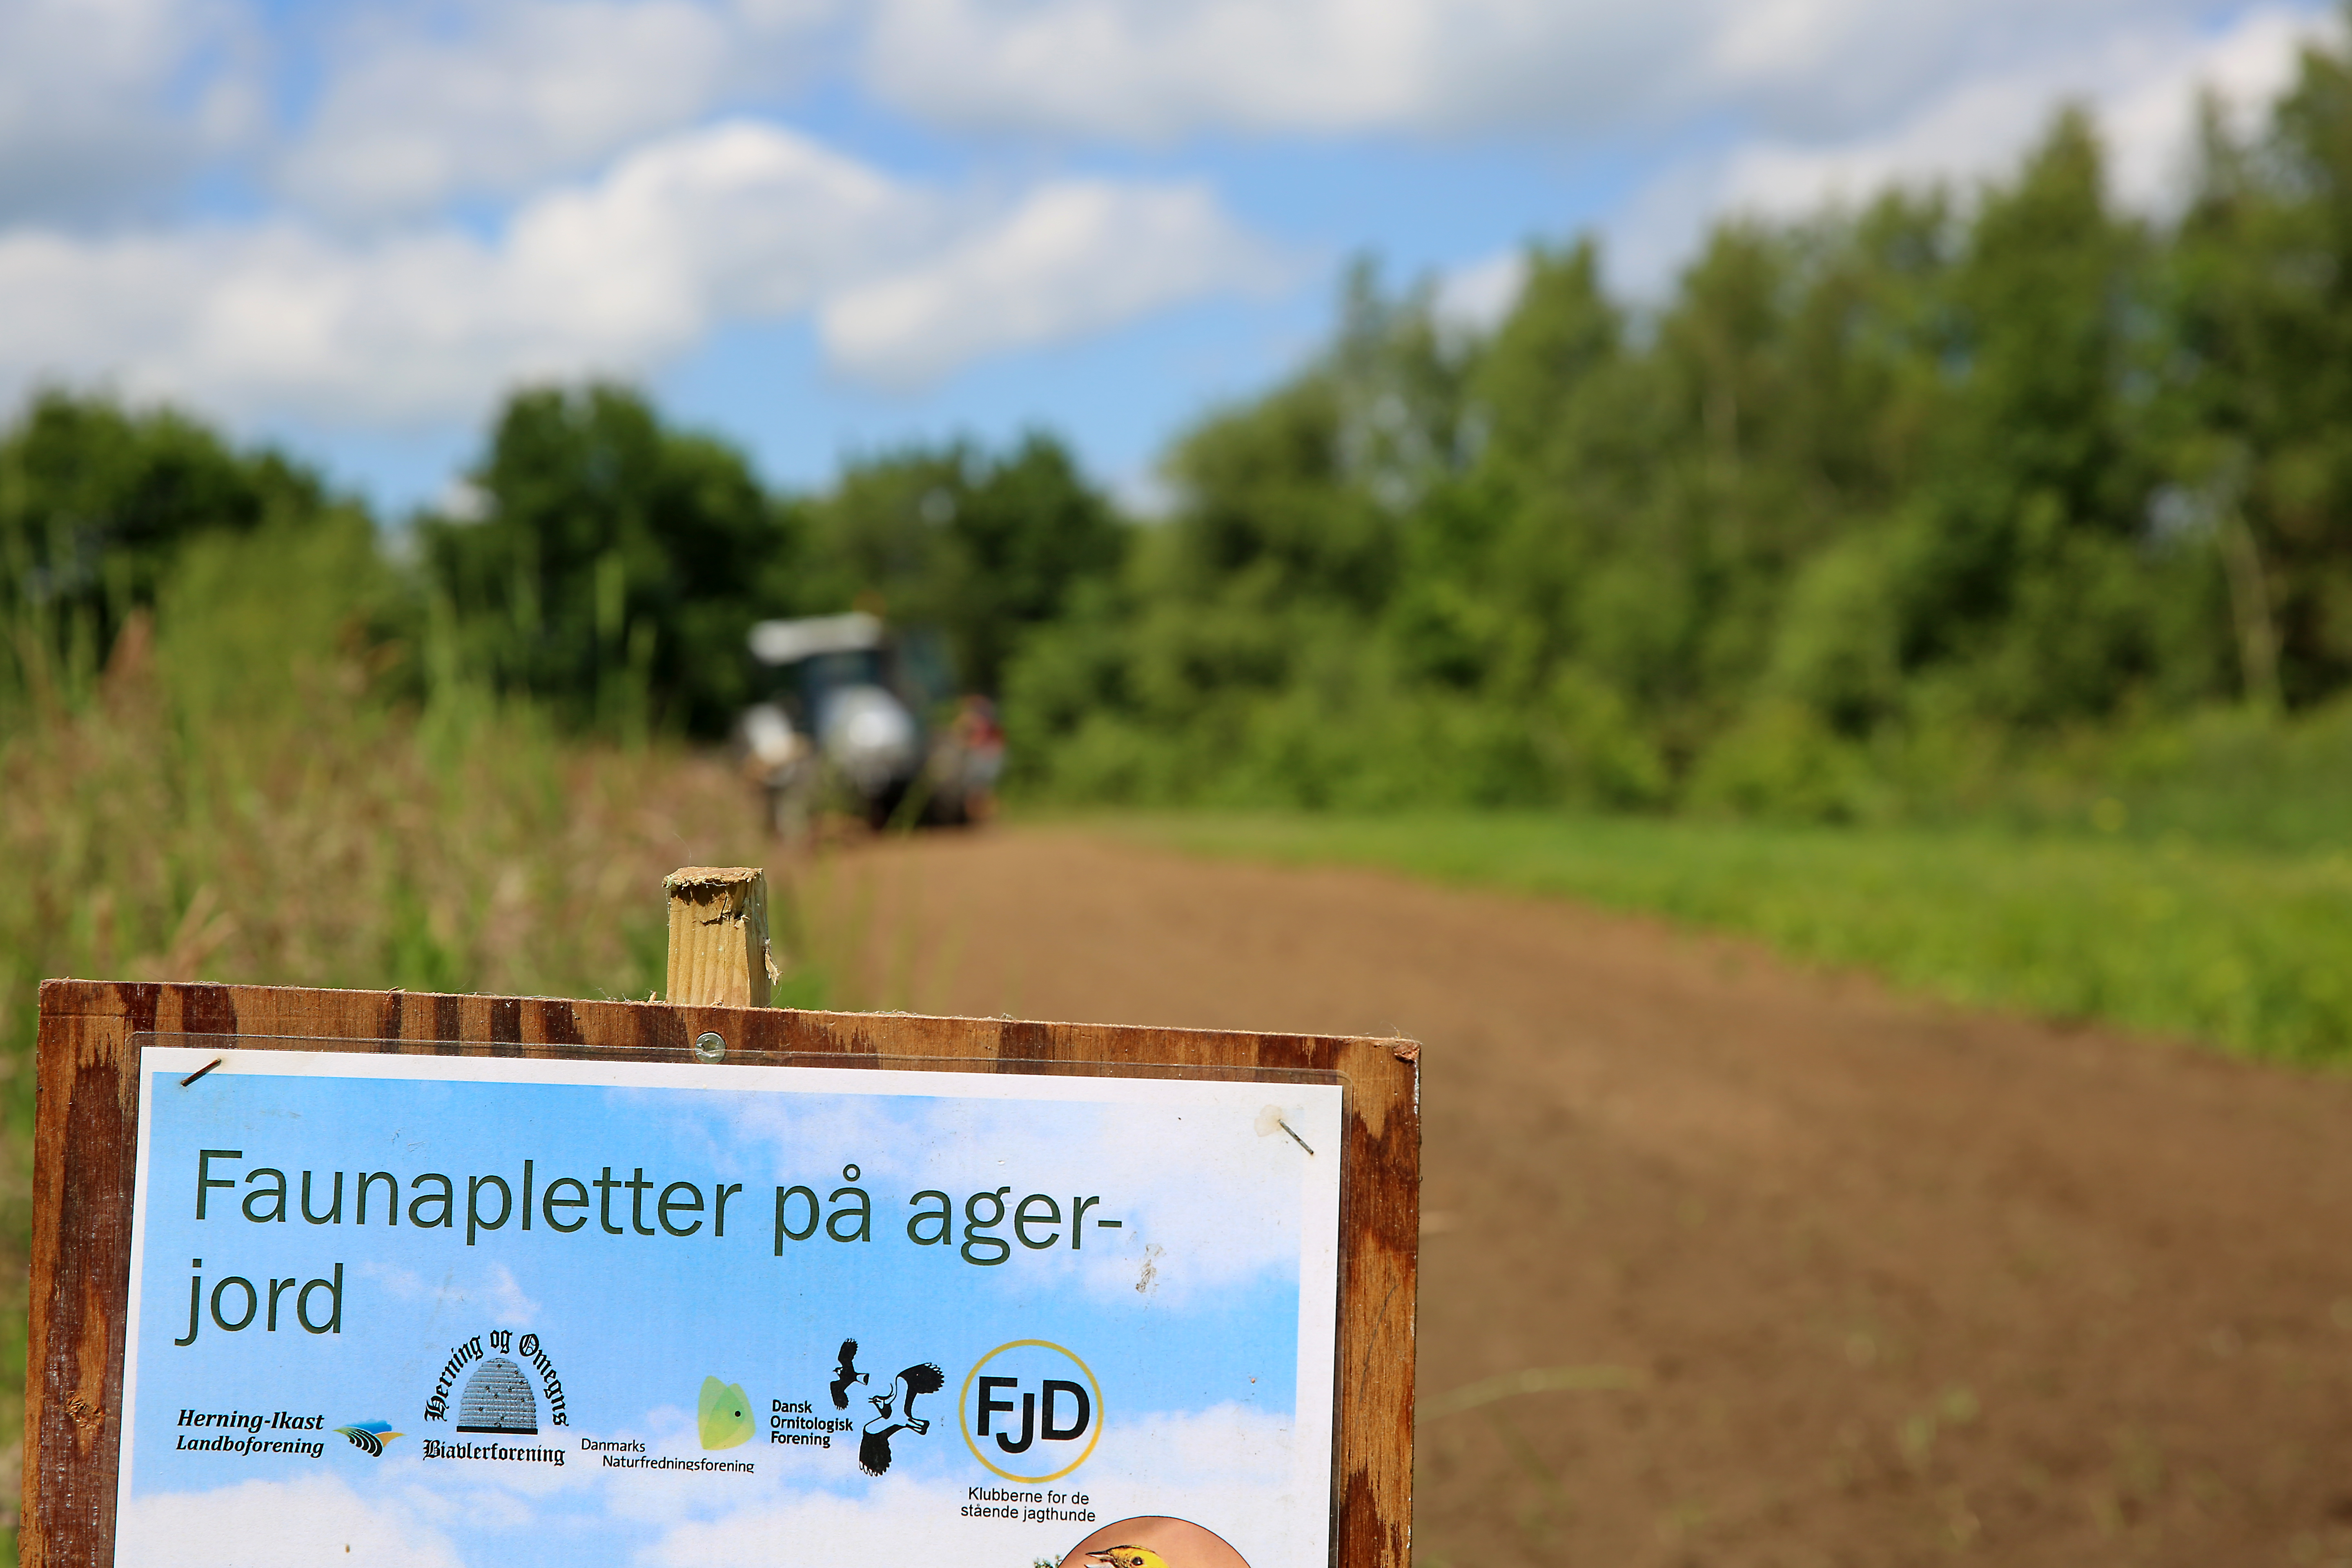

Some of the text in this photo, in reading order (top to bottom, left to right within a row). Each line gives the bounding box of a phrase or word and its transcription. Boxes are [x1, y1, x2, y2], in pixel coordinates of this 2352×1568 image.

[196, 1149, 1122, 1266] Faunapletter på ager-
[174, 1258, 343, 1346] jord
[424, 1330, 569, 1426] Herning og Omegns
[772, 1399, 812, 1413] Dansk
[978, 1376, 1090, 1454] FJD
[177, 1410, 325, 1433] Herning-Ikast
[771, 1415, 853, 1432] Ornitologisk
[176, 1435, 324, 1458] Landboforening
[581, 1438, 645, 1452] Danmarks
[771, 1432, 831, 1448] Forening
[423, 1439, 565, 1466] Biavlerforening
[603, 1455, 754, 1474] Naturfredningsforening
[969, 1487, 1089, 1504] Klubberne for de
[961, 1504, 1096, 1523] stående jagthunde
